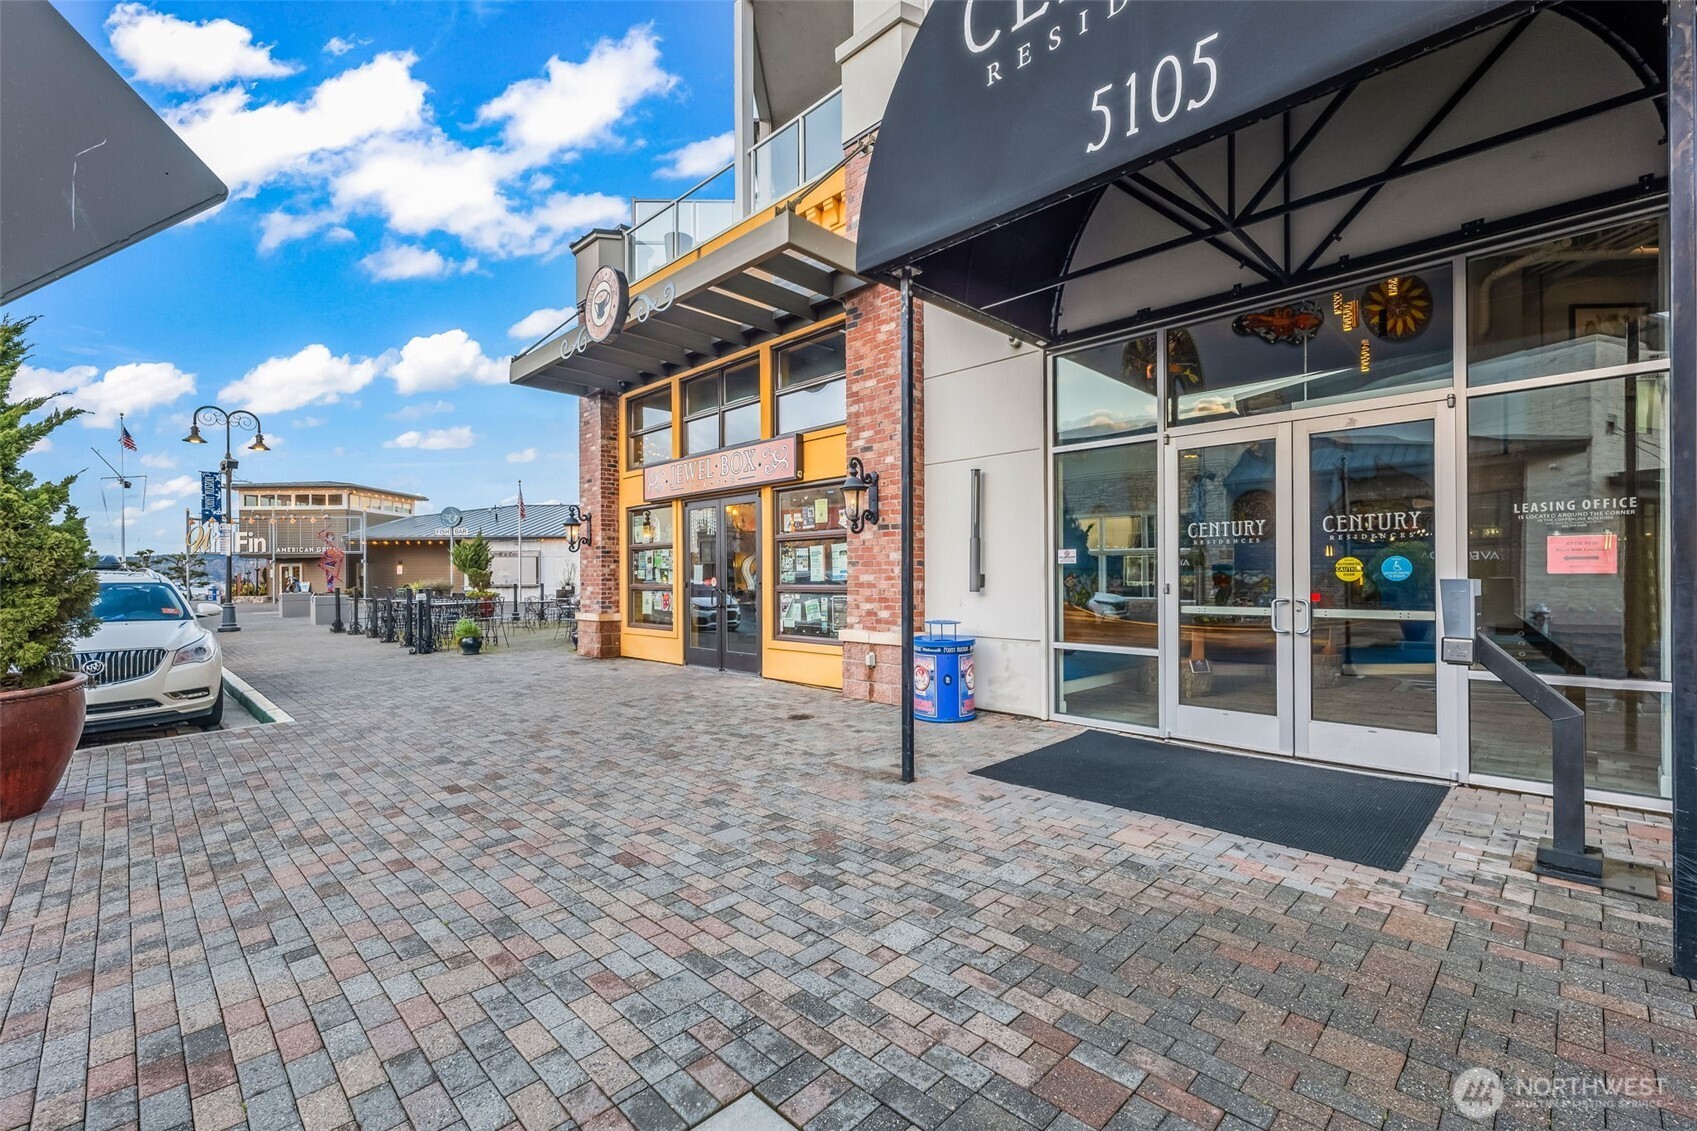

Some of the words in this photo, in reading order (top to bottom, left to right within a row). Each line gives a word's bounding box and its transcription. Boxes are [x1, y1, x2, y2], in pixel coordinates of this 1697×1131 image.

[1086, 32, 1219, 153] 5105
[670, 458, 714, 488] JEWEL
[720, 449, 756, 476] BOX
[1513, 500, 1576, 514] LEASING
[1581, 496, 1638, 510] OFFICE
[1187, 519, 1267, 538] CENTURY
[1323, 510, 1422, 533] CENTURY
[1193, 537, 1261, 545] RESIDENCES
[1329, 532, 1415, 541] RESIDENCES
